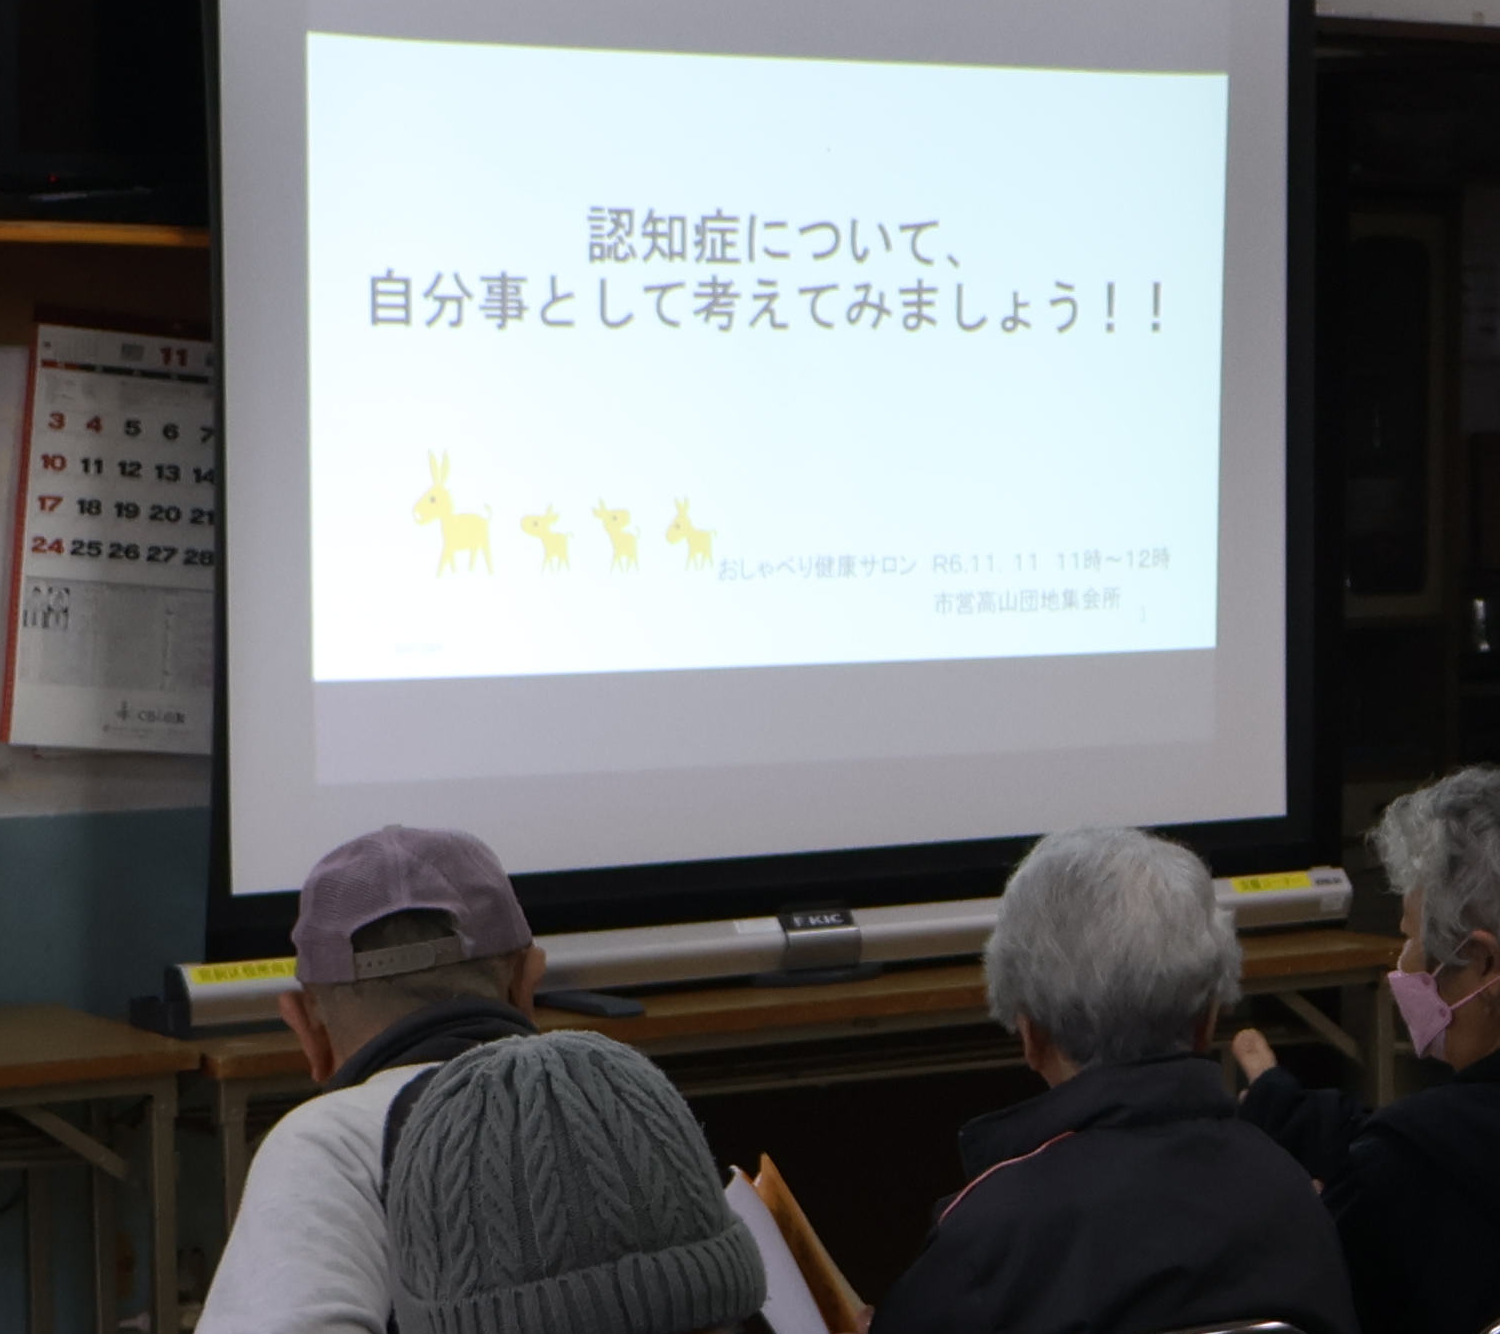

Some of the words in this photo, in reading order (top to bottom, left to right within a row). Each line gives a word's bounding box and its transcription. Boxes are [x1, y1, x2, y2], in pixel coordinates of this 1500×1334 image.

[586, 204, 963, 270] 認知症について、
[48, 412, 67, 432] 3
[86, 416, 103, 434] 4
[124, 419, 143, 438] 5
[161, 422, 180, 442] 6
[41, 453, 67, 472] 10
[80, 456, 104, 475] 11
[118, 460, 143, 479] 12
[154, 463, 182, 483] 13
[37, 494, 64, 513] 17
[76, 498, 102, 517] 18
[114, 501, 141, 521] 19
[148, 504, 182, 525] 20
[31, 535, 65, 556] 24
[70, 539, 102, 558] 25
[108, 542, 141, 561] 26
[146, 545, 179, 565] 27
[717, 553, 919, 582] おしゃべり健康サロン
[934, 586, 1123, 616] 市営高山団地集会所
